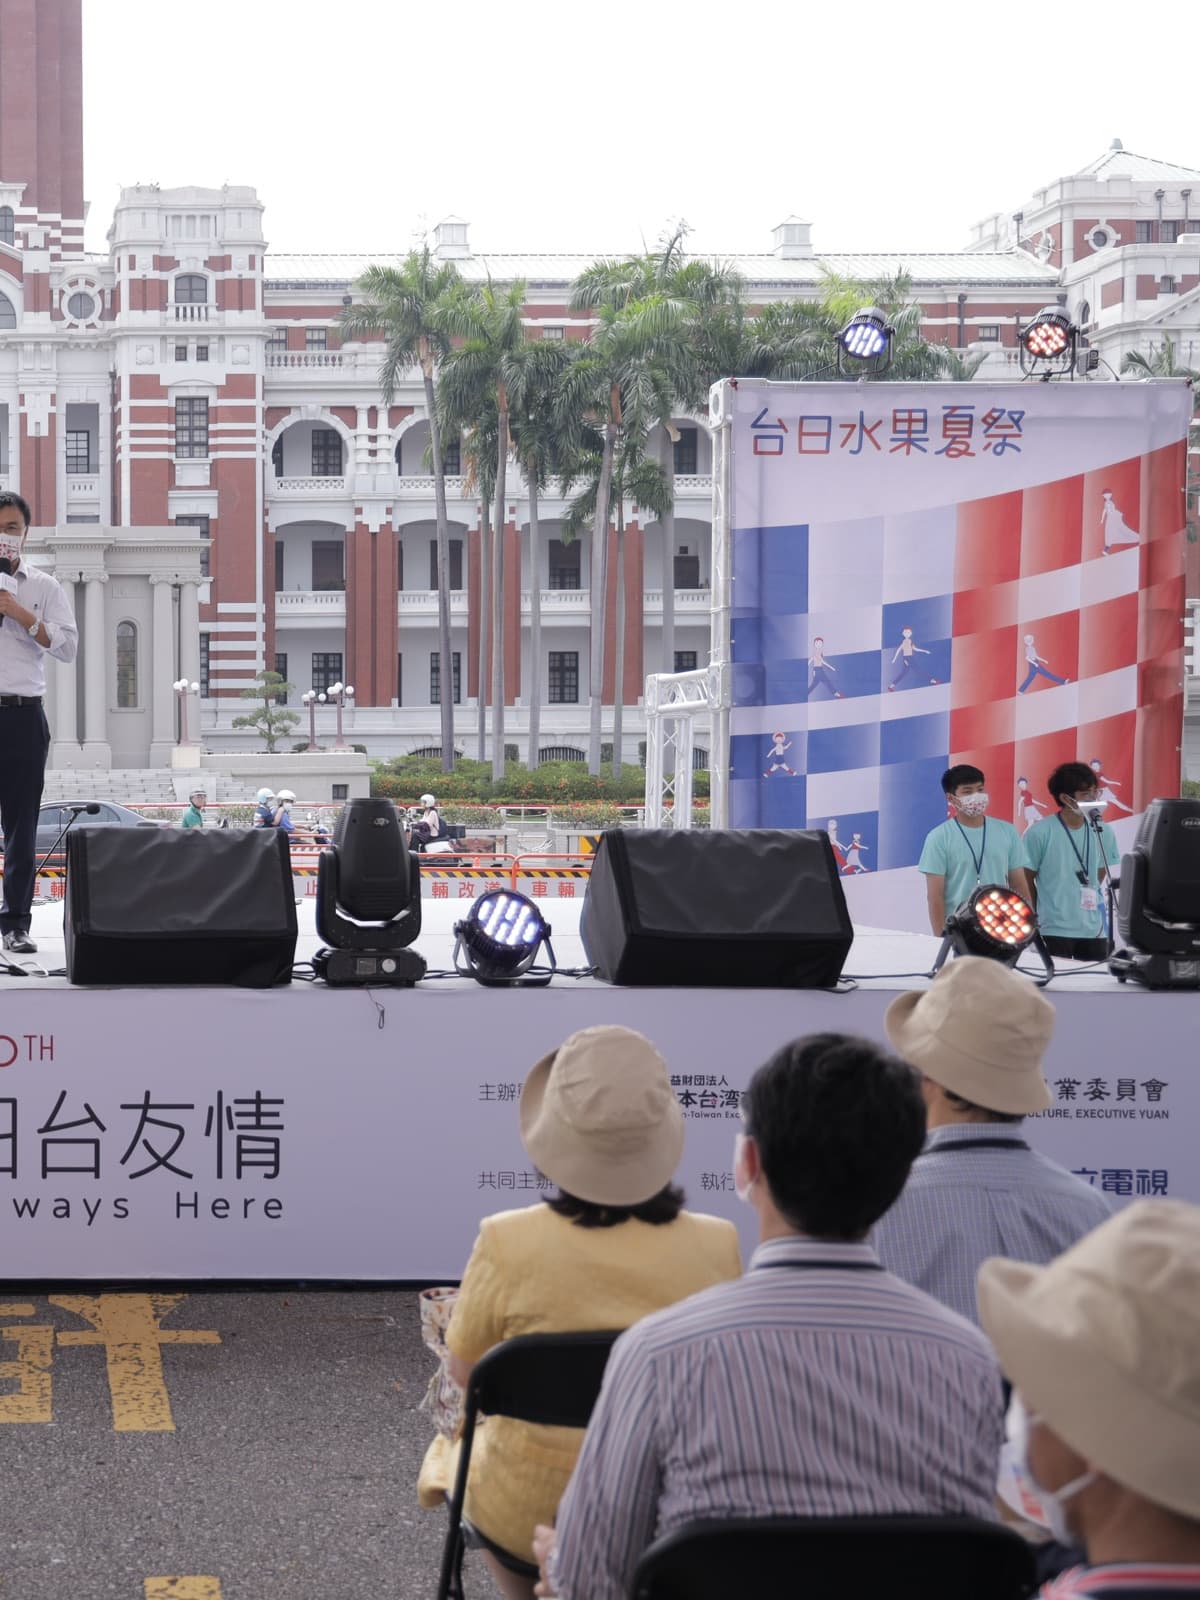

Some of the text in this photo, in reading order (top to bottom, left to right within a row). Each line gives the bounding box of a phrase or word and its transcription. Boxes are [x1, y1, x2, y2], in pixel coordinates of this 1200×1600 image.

[750, 405, 1027, 458] 台日水果夏祭
[531, 881, 575, 898] 車輛
[479, 1083, 526, 1102] 主辦
[677, 1089, 746, 1108] 本台湾
[1045, 1078, 1169, 1102] 業委員會
[1075, 1109, 1136, 1119] EXECUTIVE
[1139, 1109, 1170, 1120] YUAN
[175, 1191, 284, 1220] Here
